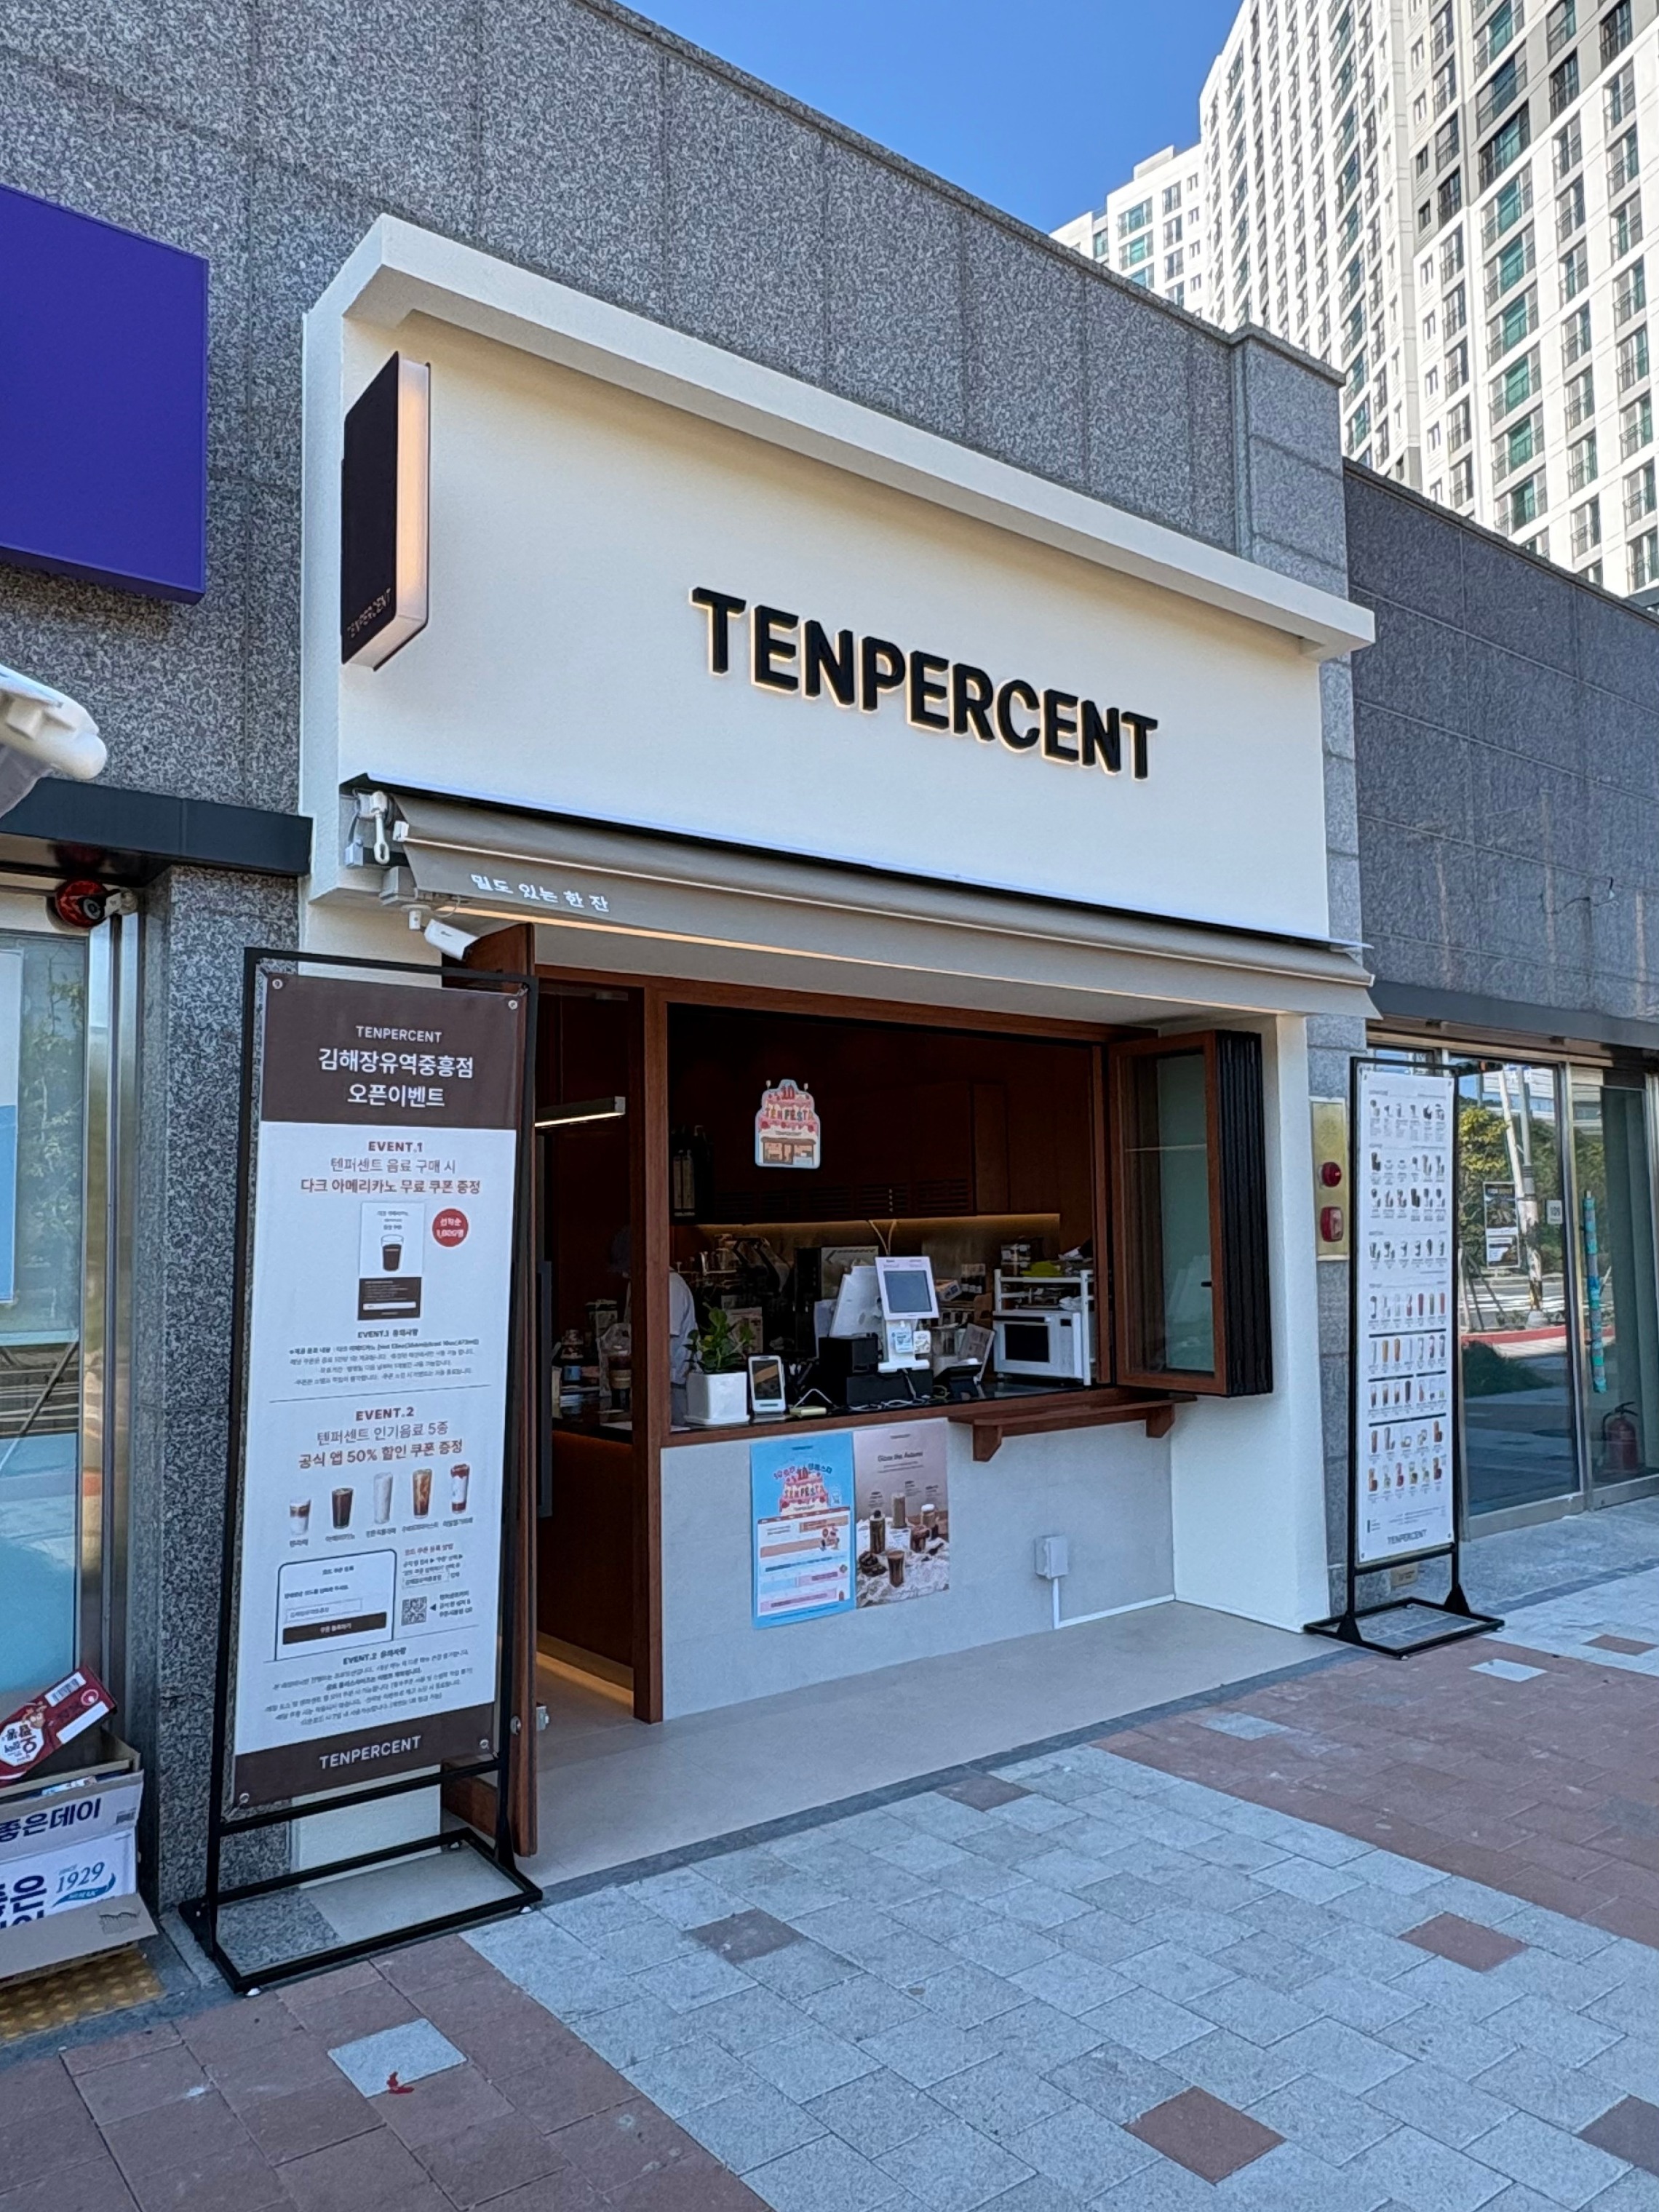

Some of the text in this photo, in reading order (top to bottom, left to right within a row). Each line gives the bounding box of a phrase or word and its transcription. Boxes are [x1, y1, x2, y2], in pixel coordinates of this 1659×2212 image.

[690, 586, 1158, 779] TENPERCENT
[518, 883, 558, 903] 있는
[563, 890, 584, 909] 한
[589, 895, 610, 912] 잔
[355, 1025, 442, 1043] TENPERCENT
[318, 1048, 474, 1079] 김해장유역중흥점
[347, 1083, 445, 1107] 오픈이벤트
[367, 1141, 423, 1153] EVENT.1
[330, 1158, 456, 1174] 텐퍼센트 음료 구매 시
[301, 1179, 480, 1194] 다크 아메리카노 무료 쿠폰 증정
[355, 1407, 415, 1422] EVENT.2
[317, 1420, 449, 1447] 텐퍼센트 인기음료 5종
[298, 1439, 464, 1469] 공식 앱 50% 할인 쿠폰 증정
[319, 1735, 422, 1770] TENPERCENT
[0, 1798, 101, 1843] 좋은데이
[56, 1861, 105, 1894] 1929
